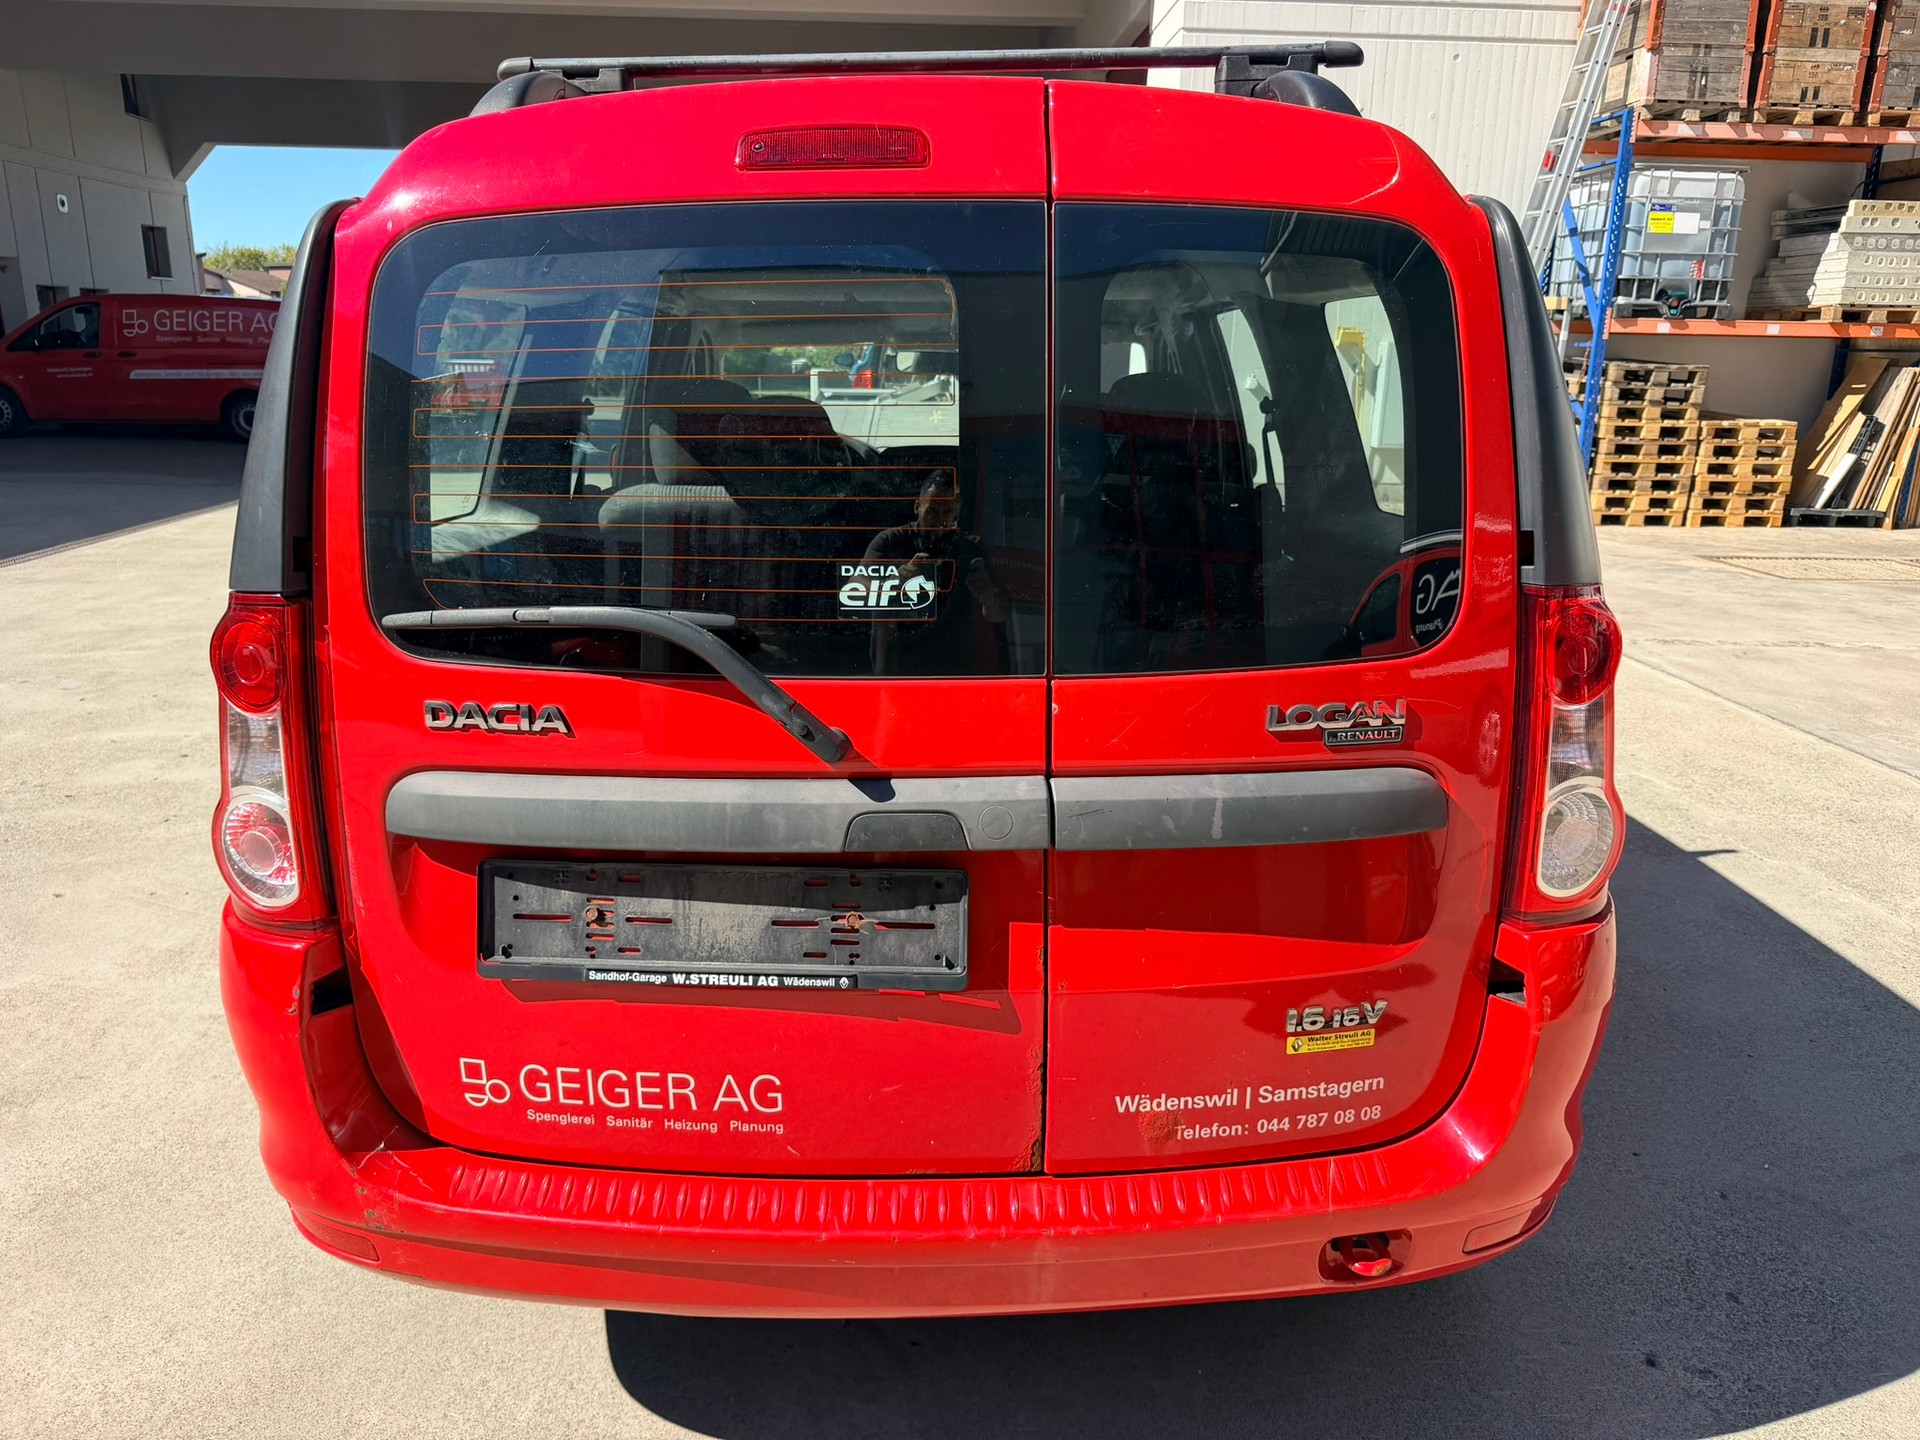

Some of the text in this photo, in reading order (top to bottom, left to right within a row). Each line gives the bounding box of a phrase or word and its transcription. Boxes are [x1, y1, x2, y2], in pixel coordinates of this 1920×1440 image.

[153, 309, 244, 332] GEIGER
[841, 565, 899, 576] DACIA
[839, 580, 899, 606] elf
[424, 700, 569, 733] DACIA
[1266, 699, 1406, 731] LOGAN
[1337, 730, 1397, 741] RENAULT
[588, 970, 836, 988] Sandhof-Garage W.STREULI AG Wädenswil
[1286, 1007, 1325, 1032] 1.6
[519, 1063, 785, 1114] GEIGER AG
[1115, 1088, 1238, 1114] Wädenswil
[1257, 1076, 1386, 1104] Samstagern
[526, 1108, 785, 1135] Spenglerei Sanitär Heizung Planung
[1175, 1104, 1382, 1141] Telefon: 044 787 08 08
